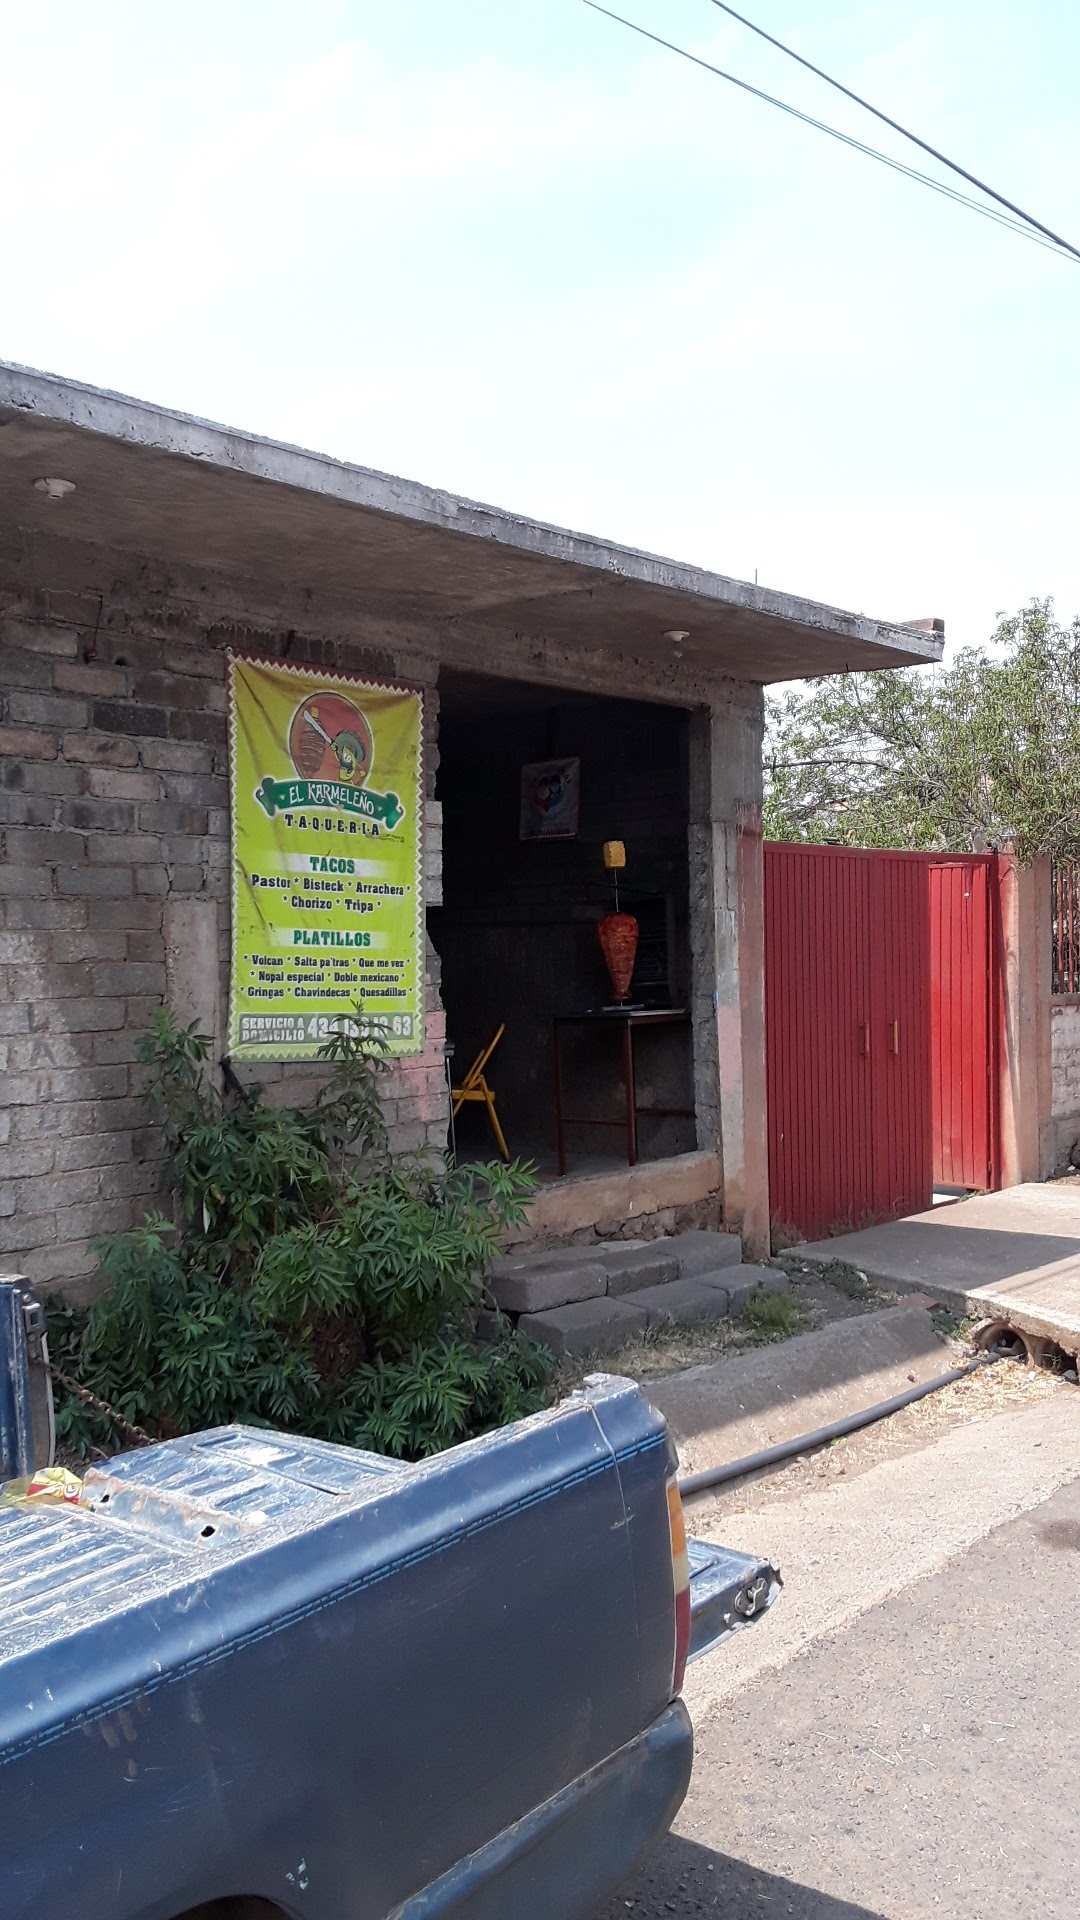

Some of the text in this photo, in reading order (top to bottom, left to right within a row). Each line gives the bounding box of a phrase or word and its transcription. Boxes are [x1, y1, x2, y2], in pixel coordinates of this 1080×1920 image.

[289, 782, 374, 815] EL KARMELEÑO
[309, 856, 355, 874] TACOS
[251, 874, 404, 896] Pastor Bisteck Arrachera
[291, 895, 374, 914] Chorizo Tripa
[293, 930, 371, 947] PLATILLOS
[251, 955, 284, 966] Volcan
[294, 956, 318, 967] Salta
[358, 958, 375, 968] Que
[377, 959, 389, 967] me
[391, 960, 405, 968] vez
[258, 971, 399, 984] Nopal especial Doble mexicano
[247, 987, 407, 999] Gringas Chavindecas Quesadillas
[242, 1017, 305, 1029] SERVICIO A
[392, 1015, 412, 1036] 63
